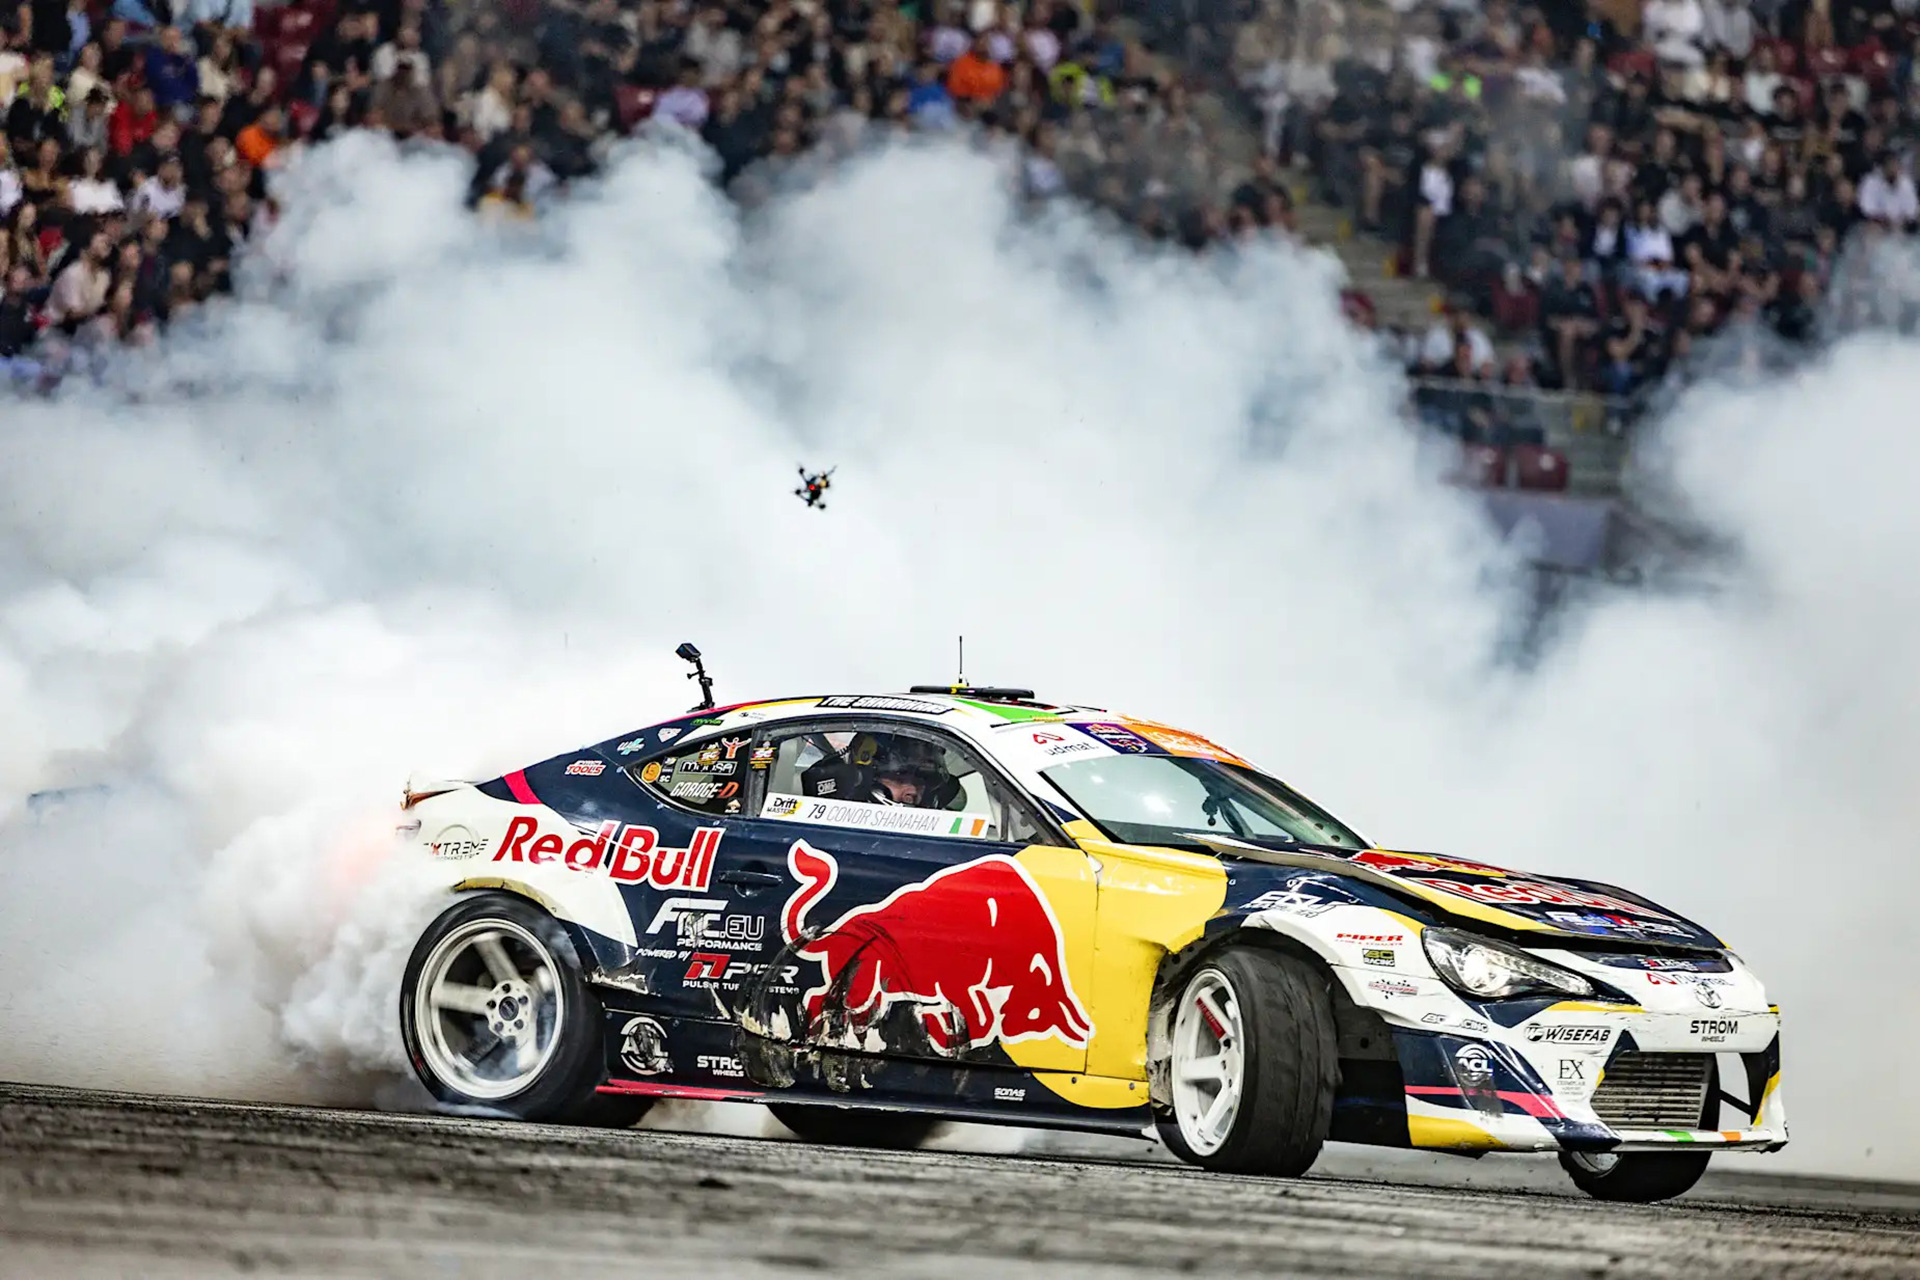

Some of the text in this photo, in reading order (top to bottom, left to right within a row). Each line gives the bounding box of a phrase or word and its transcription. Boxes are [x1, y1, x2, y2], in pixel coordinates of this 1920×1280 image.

[818, 781, 836, 793] OMP
[773, 797, 798, 809] Drift
[808, 804, 940, 831] 79 CONOR SHANAHAN
[492, 815, 722, 889] Red Bull
[1336, 933, 1403, 942] PIPER
[635, 948, 677, 959] POWERED
[1545, 1028, 1611, 1041] WISEFAB
[1458, 1058, 1494, 1073] ACL
[1558, 1059, 1584, 1079] EX
[713, 1069, 745, 1077] WHEELS
